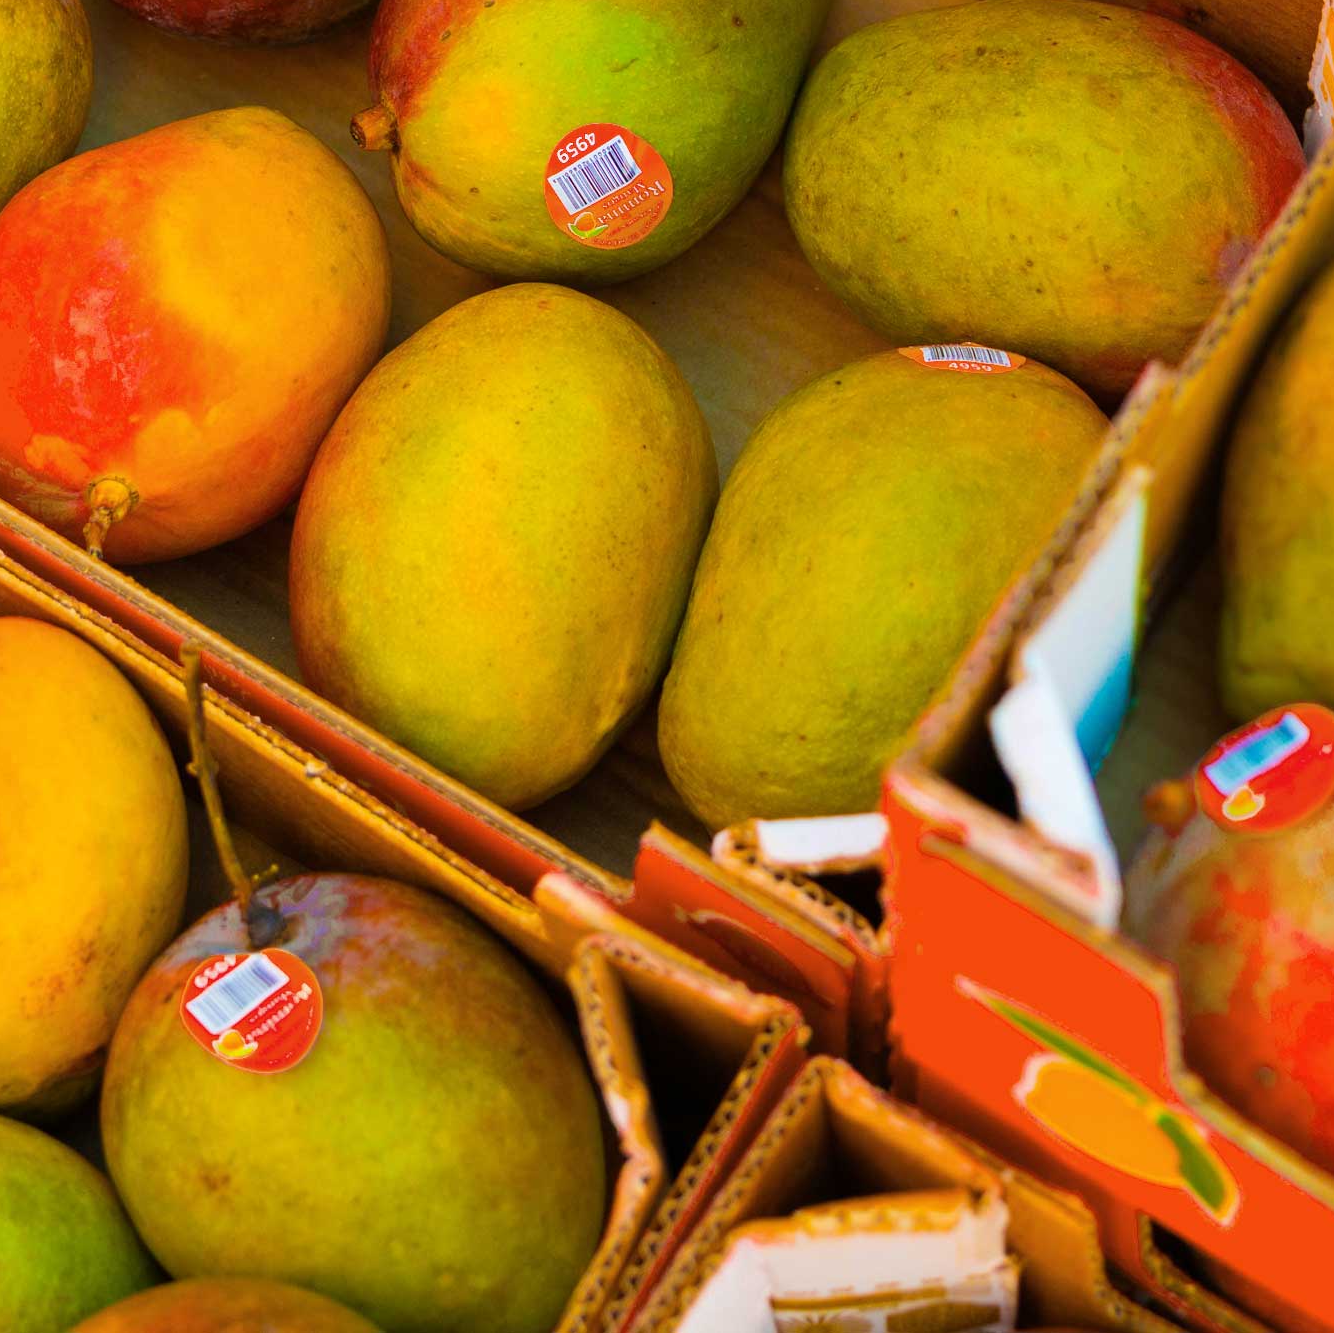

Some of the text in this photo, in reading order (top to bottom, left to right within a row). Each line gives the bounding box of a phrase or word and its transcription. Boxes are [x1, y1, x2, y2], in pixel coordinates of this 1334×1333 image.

[556, 132, 596, 164] 4959
[598, 181, 665, 223] Romina
[949, 362, 992, 372] 4959
